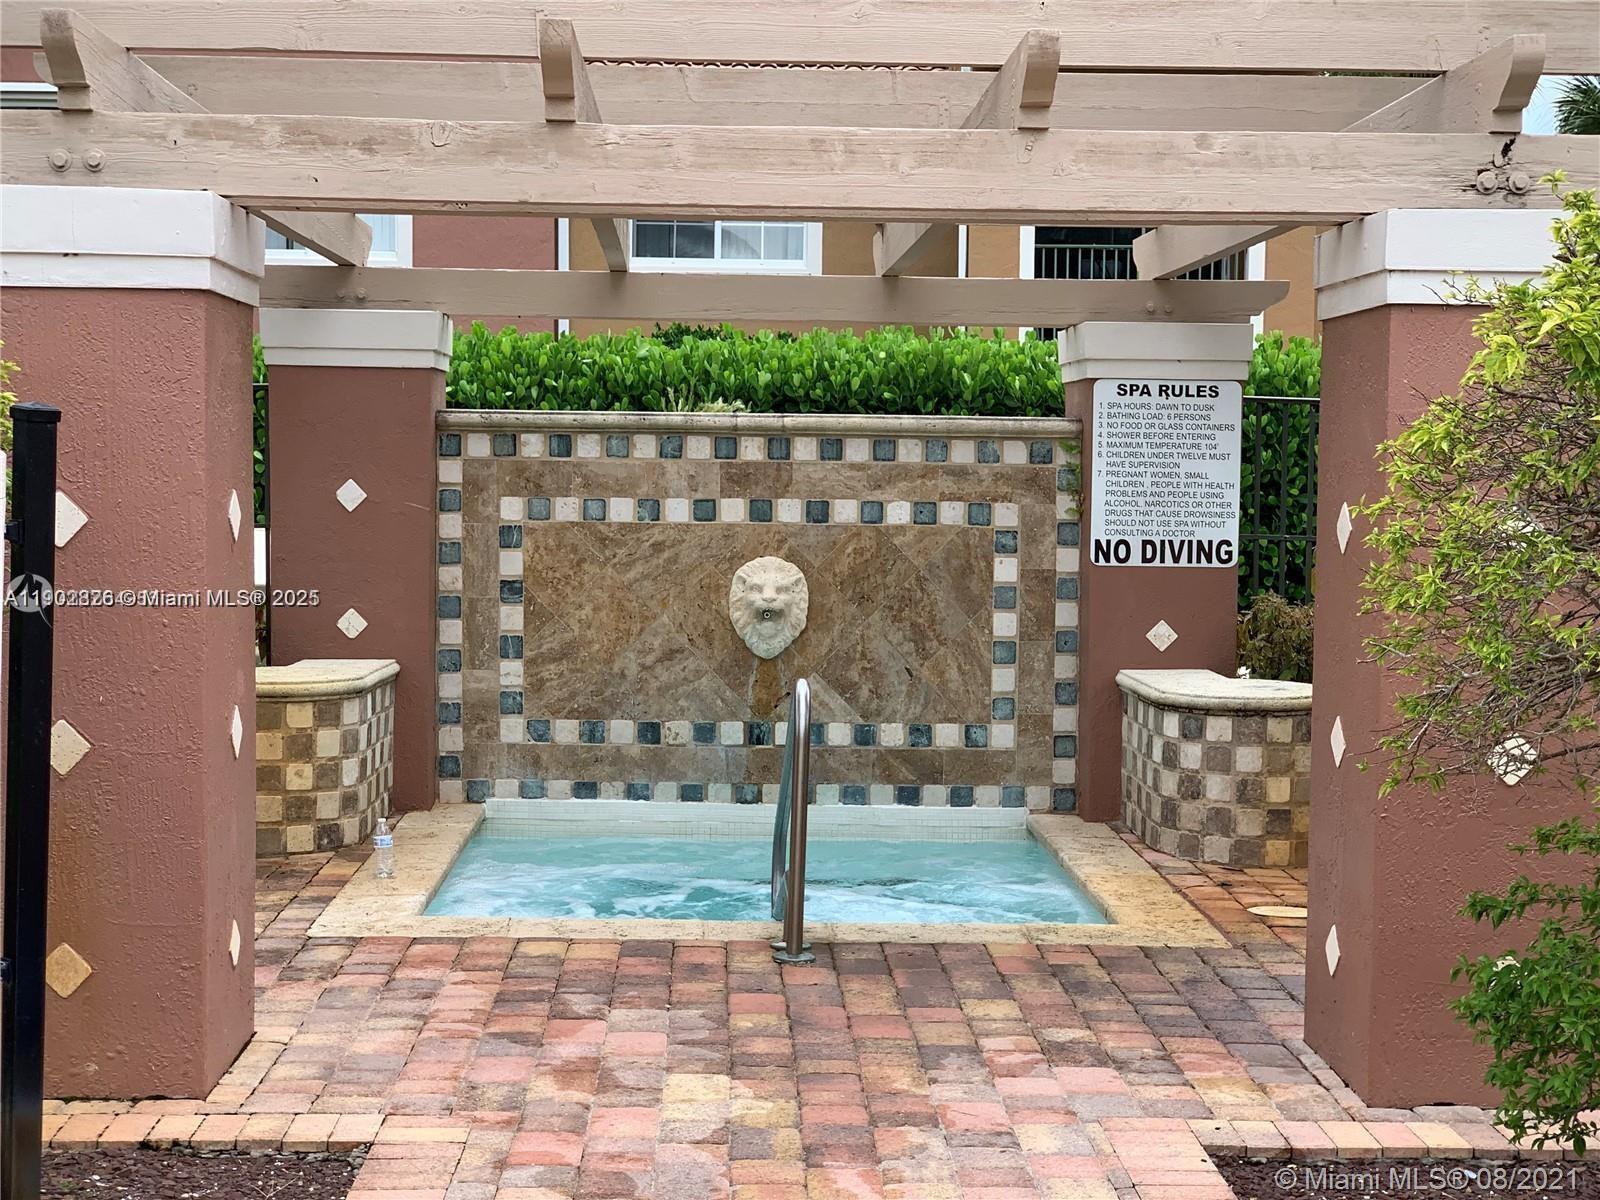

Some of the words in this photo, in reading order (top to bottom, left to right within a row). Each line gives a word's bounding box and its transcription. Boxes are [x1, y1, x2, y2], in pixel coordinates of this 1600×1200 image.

[1117, 384, 1151, 396] SPA
[1159, 384, 1219, 398] RULES
[1094, 539, 1131, 564] NO
[1141, 539, 1234, 564] DIVING
